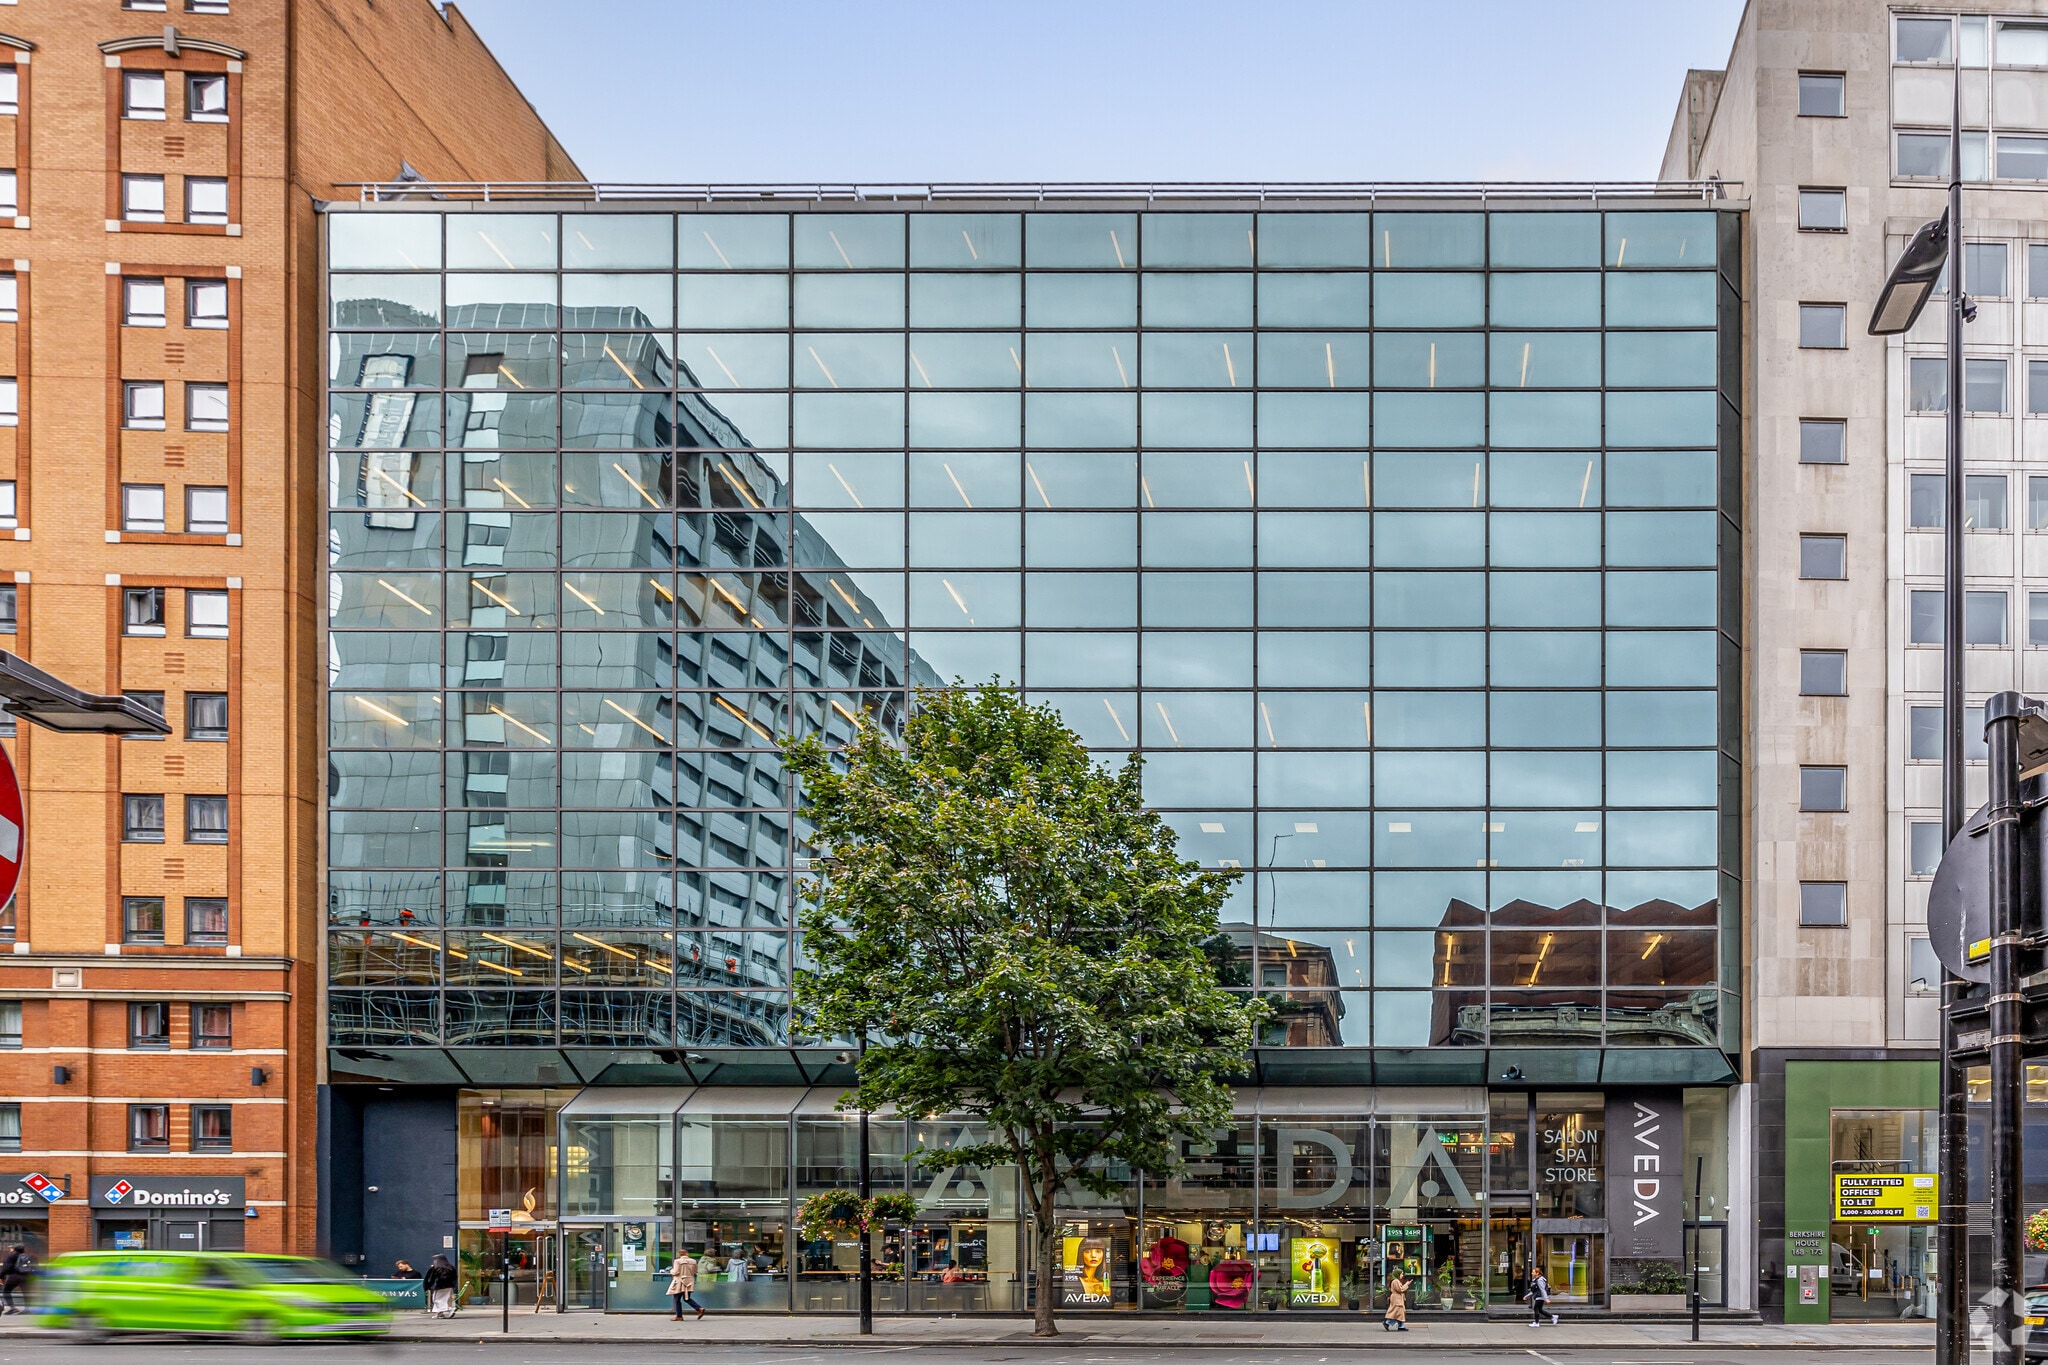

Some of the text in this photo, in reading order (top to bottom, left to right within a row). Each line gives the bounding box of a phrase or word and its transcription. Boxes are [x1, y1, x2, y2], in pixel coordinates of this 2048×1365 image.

[1544, 1130, 1598, 1144] SALON
[1555, 1149, 1587, 1163] SPA
[1633, 1102, 1660, 1227] AVEDA
[1545, 1168, 1598, 1182] STORE
[134, 1189, 230, 1205] Domino's
[1065, 1293, 1110, 1303] AVEDA
[1293, 1294, 1338, 1303] AVEDA
